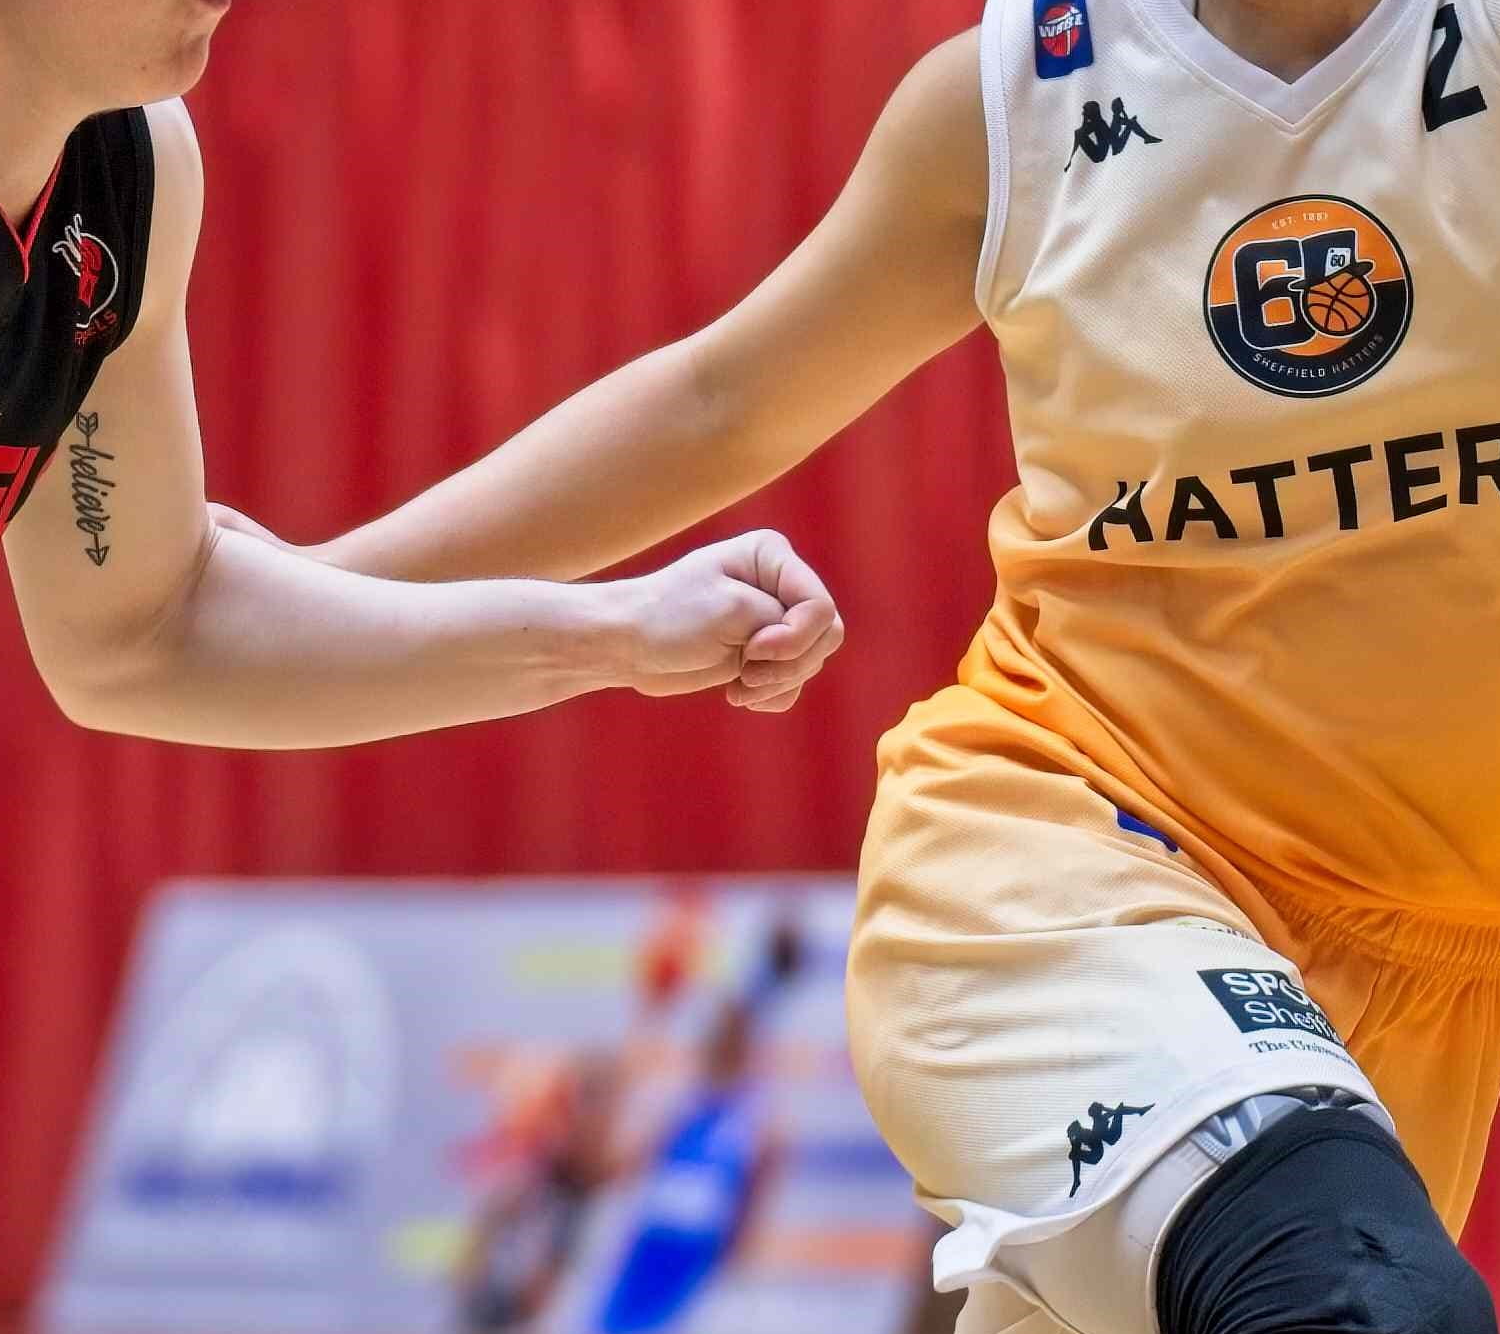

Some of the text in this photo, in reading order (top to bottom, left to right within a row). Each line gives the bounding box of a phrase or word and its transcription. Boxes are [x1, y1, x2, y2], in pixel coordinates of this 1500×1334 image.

[1422, 3, 1487, 132] 2
[1330, 254, 1347, 268] 60
[1252, 332, 1385, 379] SHEFFIELD HATTERS
[68, 443, 116, 537] believe
[1249, 1040, 1289, 1053] The
